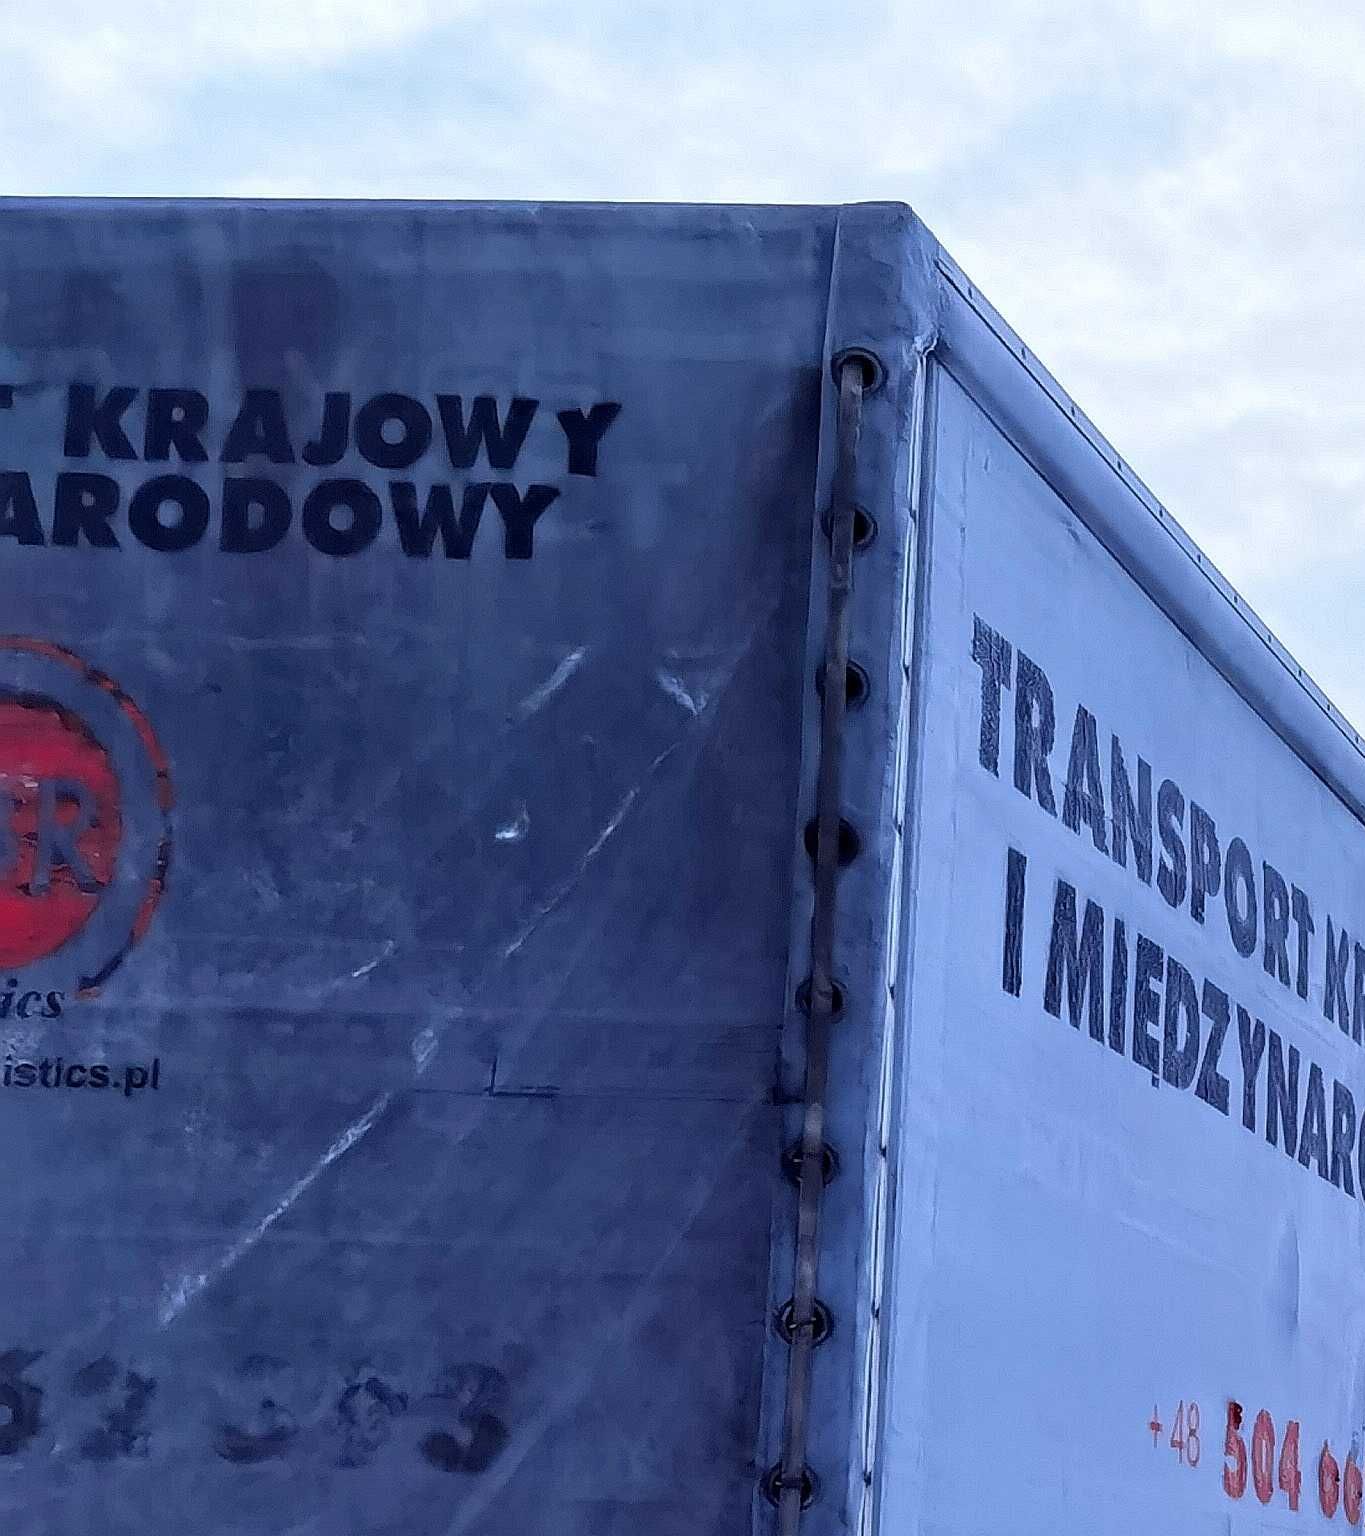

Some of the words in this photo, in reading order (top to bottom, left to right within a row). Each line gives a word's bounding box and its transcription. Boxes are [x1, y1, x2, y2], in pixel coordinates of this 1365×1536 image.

[63, 382, 623, 478] KRAJOWY
[972, 611, 1315, 1000] TRANSPORT
[1001, 847, 1028, 998] I
[1223, 1397, 1301, 1513] 504
